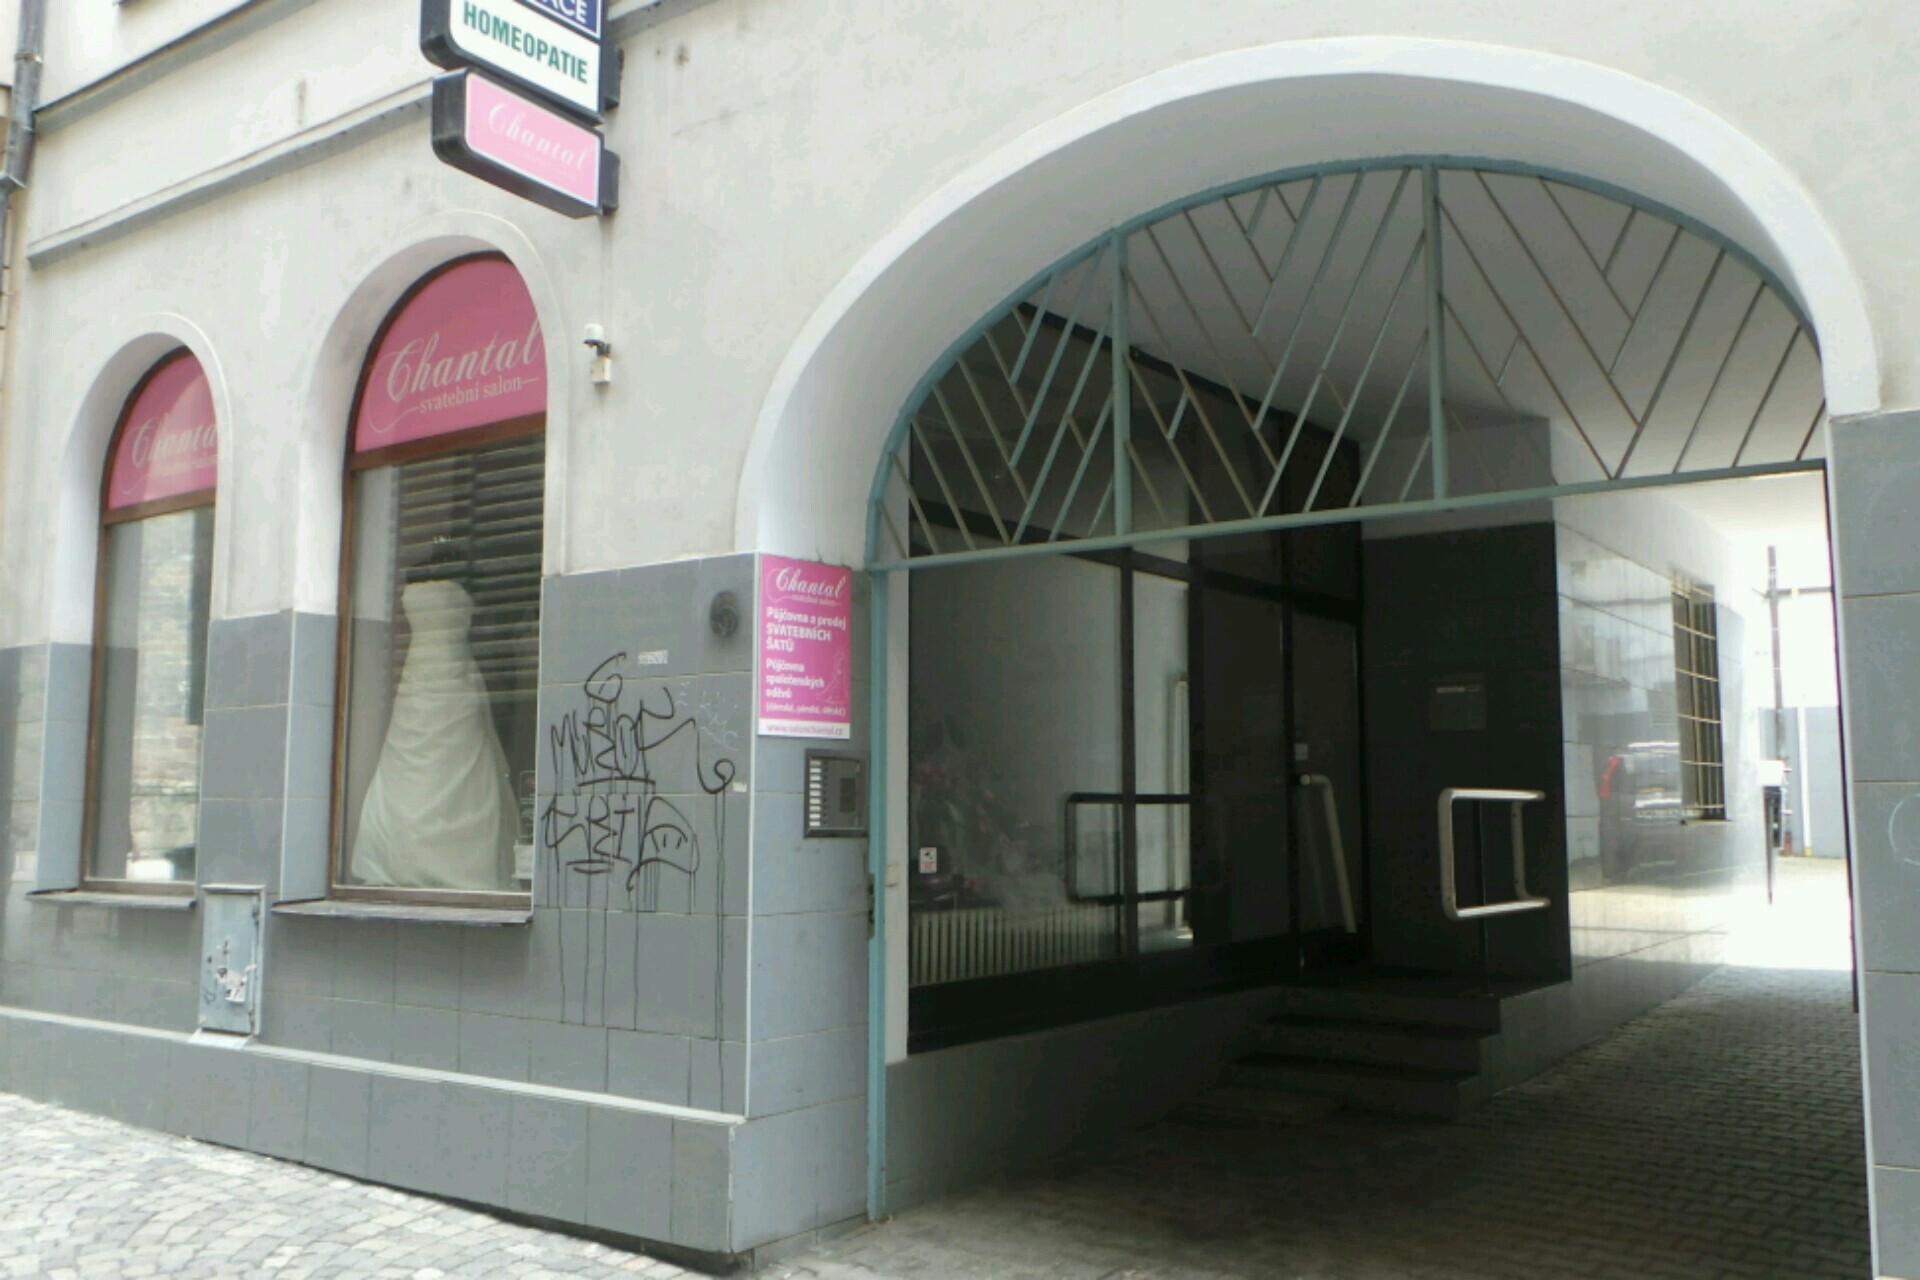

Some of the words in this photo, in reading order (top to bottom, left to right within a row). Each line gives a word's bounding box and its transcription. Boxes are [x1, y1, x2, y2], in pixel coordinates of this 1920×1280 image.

[463, 2, 587, 84] HOMEOPATIE
[488, 103, 589, 170] Chantal
[386, 316, 542, 404] Chantal
[483, 375, 523, 398] salon
[132, 412, 217, 470] Chanta
[775, 567, 847, 600] Chantal
[817, 616, 846, 632] prodej
